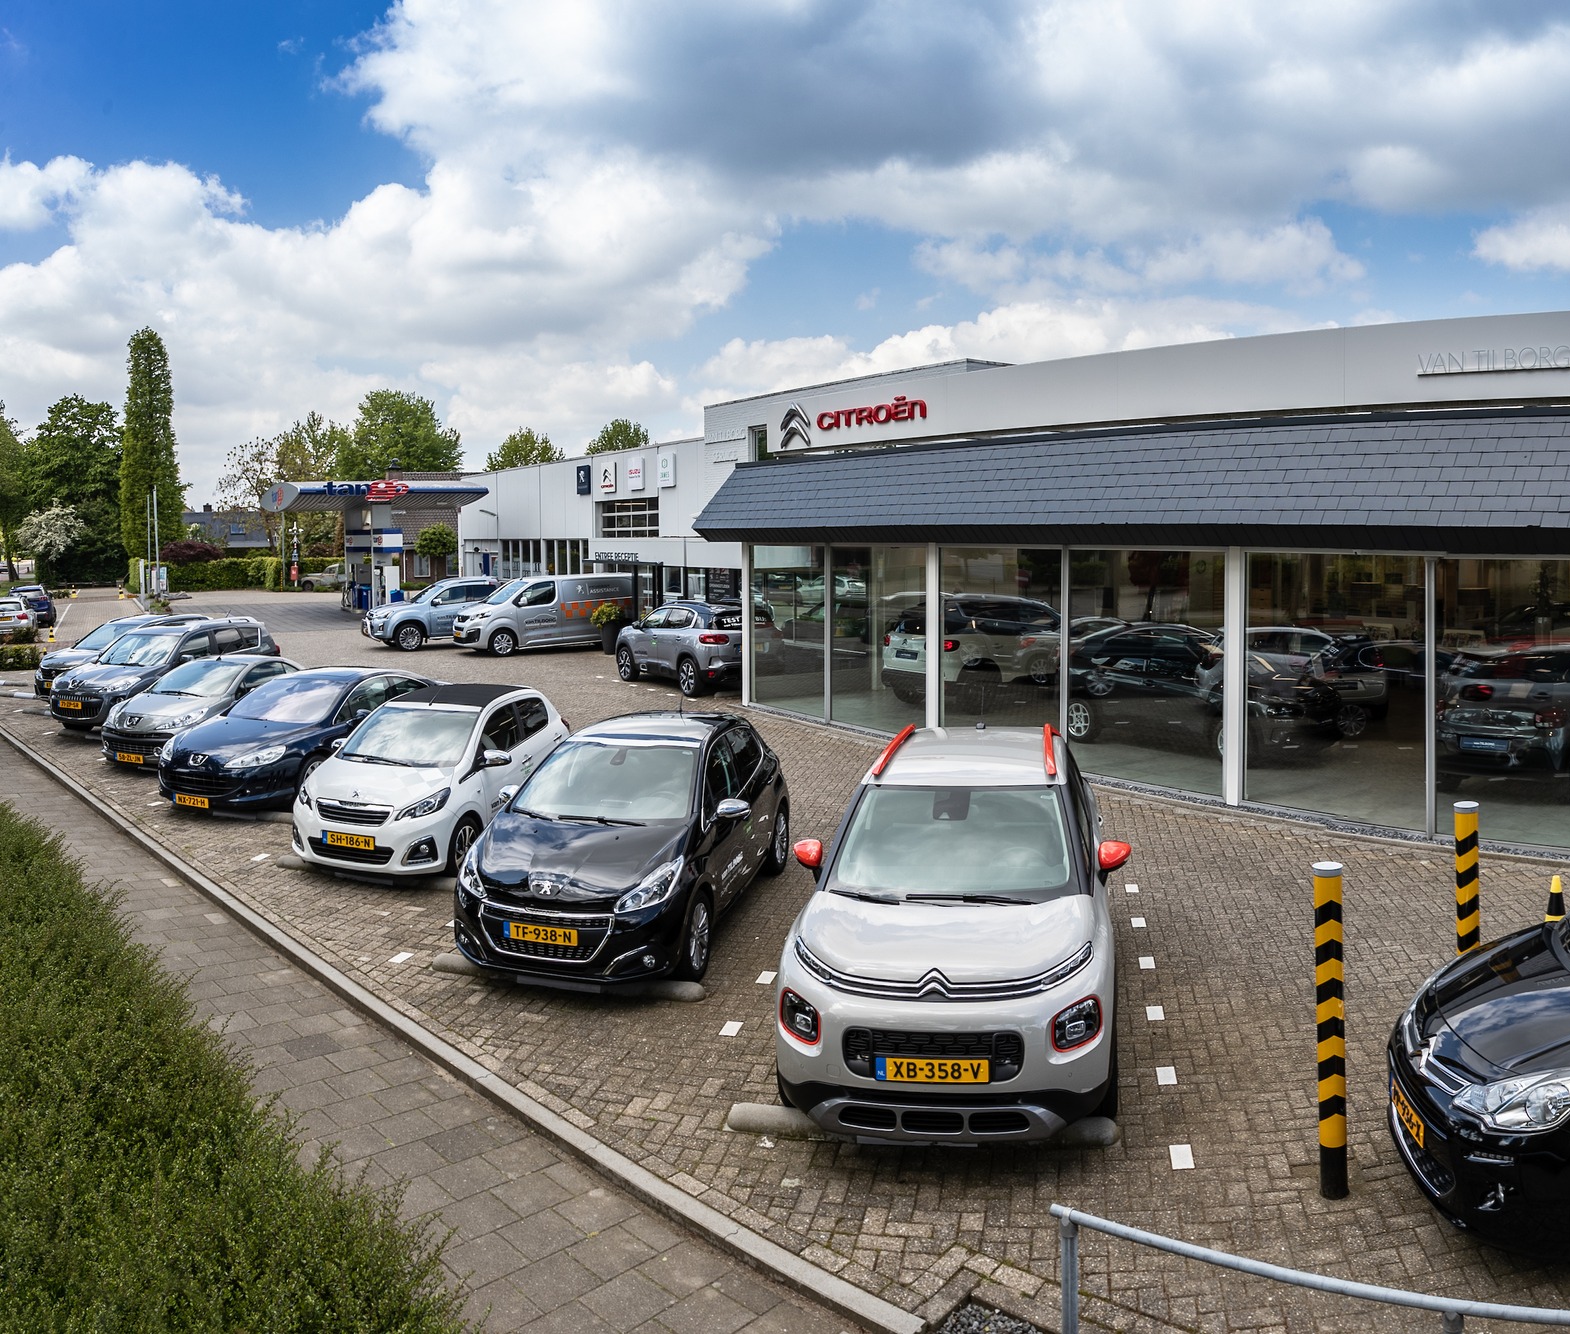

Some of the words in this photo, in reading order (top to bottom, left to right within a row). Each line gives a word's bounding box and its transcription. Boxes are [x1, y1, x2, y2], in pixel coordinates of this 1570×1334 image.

[1417, 352, 1465, 373] VAN
[323, 479, 410, 502] tango
[721, 615, 741, 624] TEST
[177, 794, 206, 807] NX-721-H
[330, 833, 371, 849] SH-186-N
[514, 925, 572, 943] TF-938-N
[893, 1061, 981, 1080] XB-358-V
